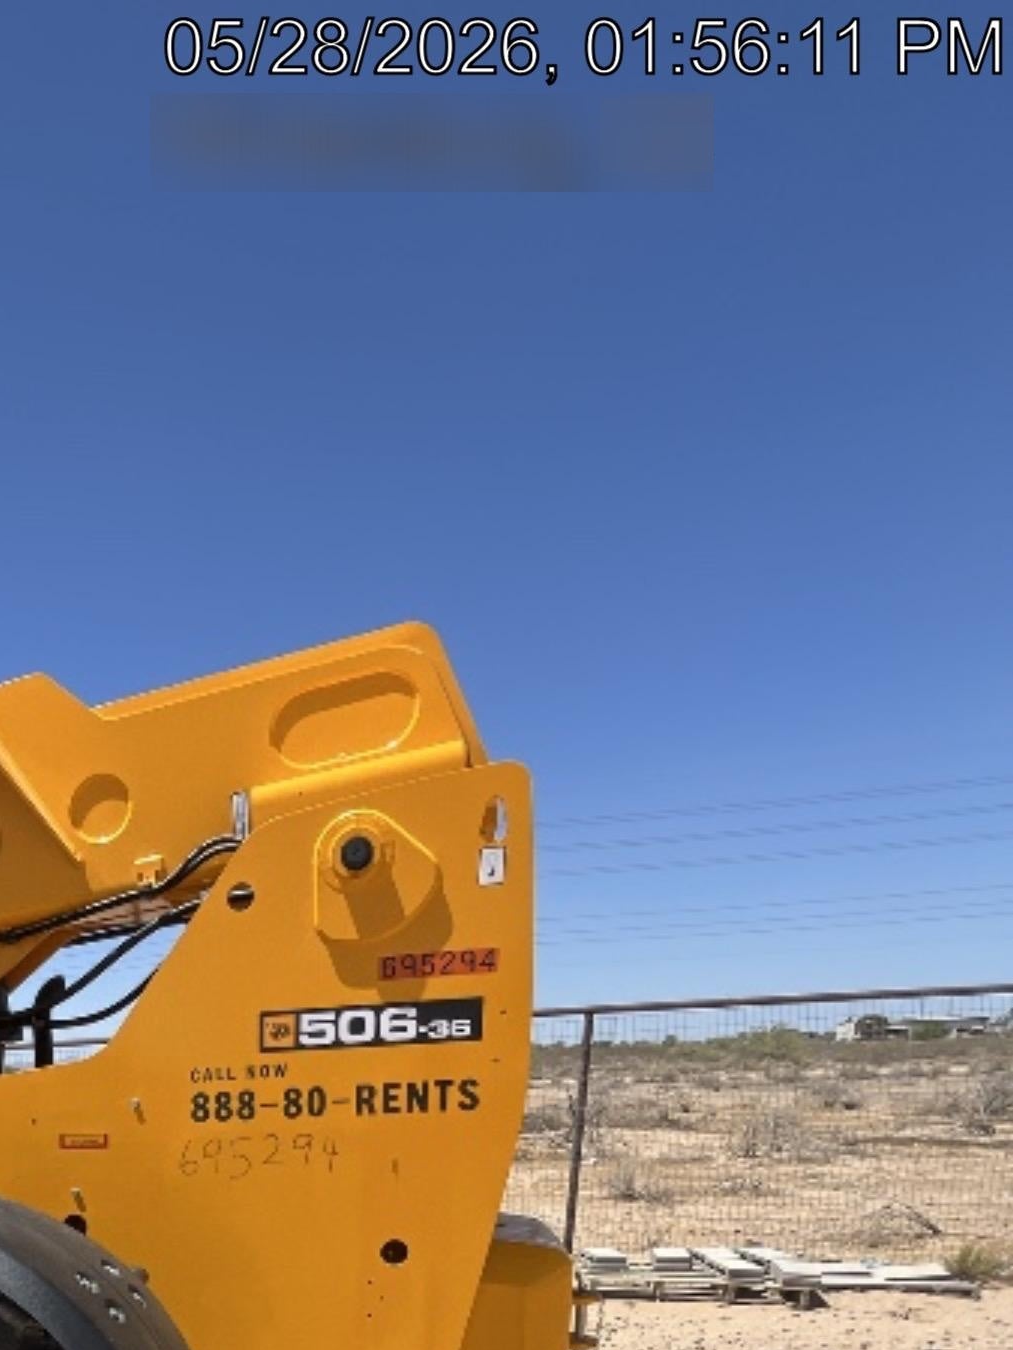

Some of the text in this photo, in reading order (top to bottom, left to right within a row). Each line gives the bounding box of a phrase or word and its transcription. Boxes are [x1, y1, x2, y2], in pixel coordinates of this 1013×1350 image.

[382, 948, 496, 979] 695294
[190, 1063, 288, 1084] CALL NOW
[190, 1079, 481, 1123] 888-80-RENTS
[179, 1133, 339, 1180] 695294
